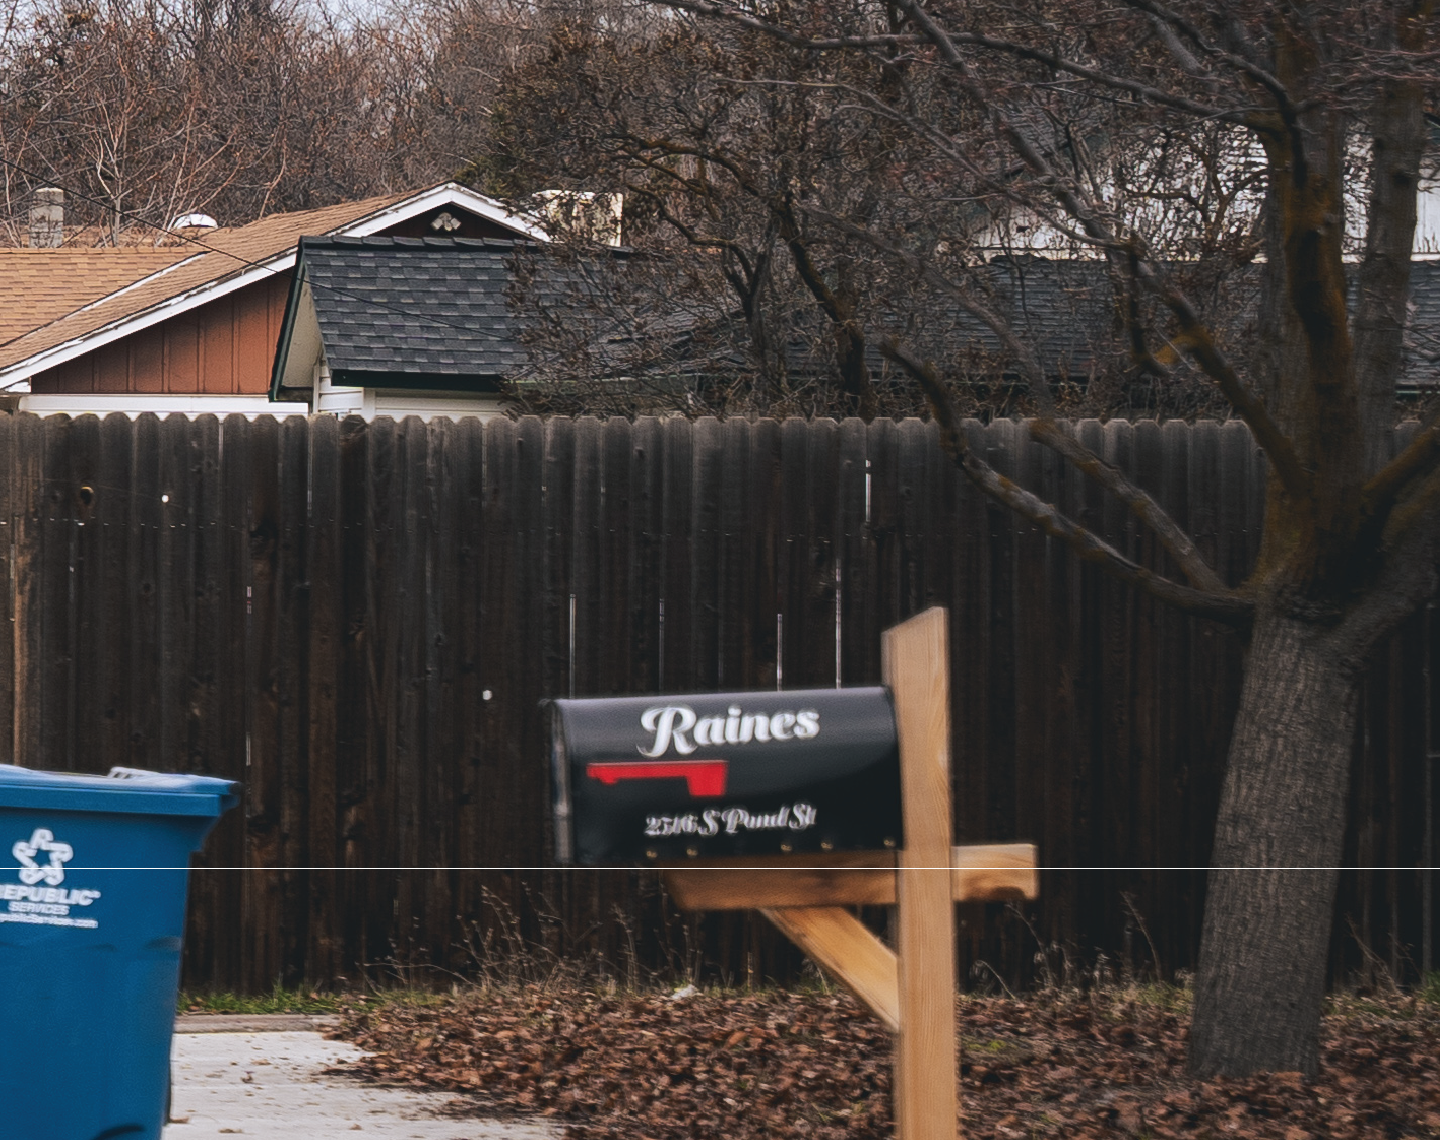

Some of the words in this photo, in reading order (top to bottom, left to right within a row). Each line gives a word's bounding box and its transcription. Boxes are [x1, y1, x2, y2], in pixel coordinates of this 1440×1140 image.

[636, 705, 821, 758] Raines
[698, 808, 721, 836] S
[788, 802, 817, 830] St
[8, 901, 70, 916] SERVICES
